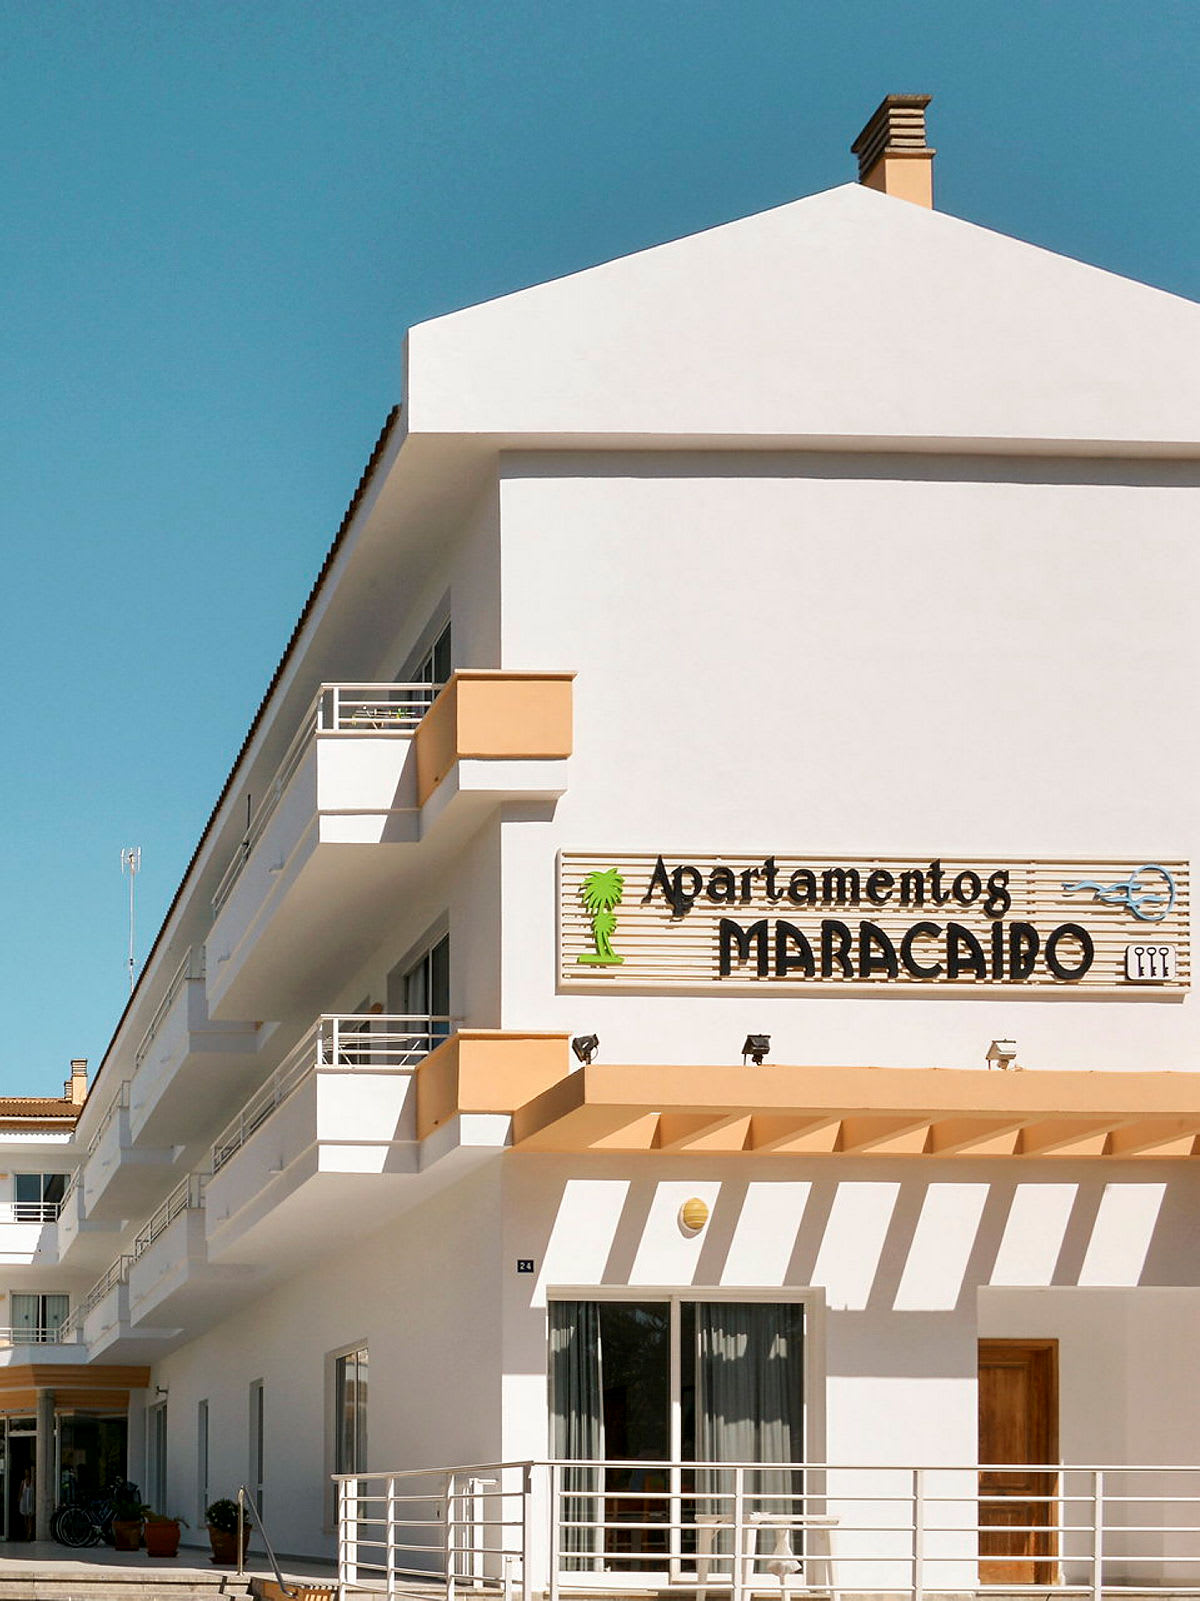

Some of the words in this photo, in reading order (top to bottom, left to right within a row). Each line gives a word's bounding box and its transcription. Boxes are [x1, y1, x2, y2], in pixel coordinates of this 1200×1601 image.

[640, 854, 1011, 919] Apartamentos
[719, 918, 1094, 980] MARACAIBO
[519, 1262, 532, 1270] 24
